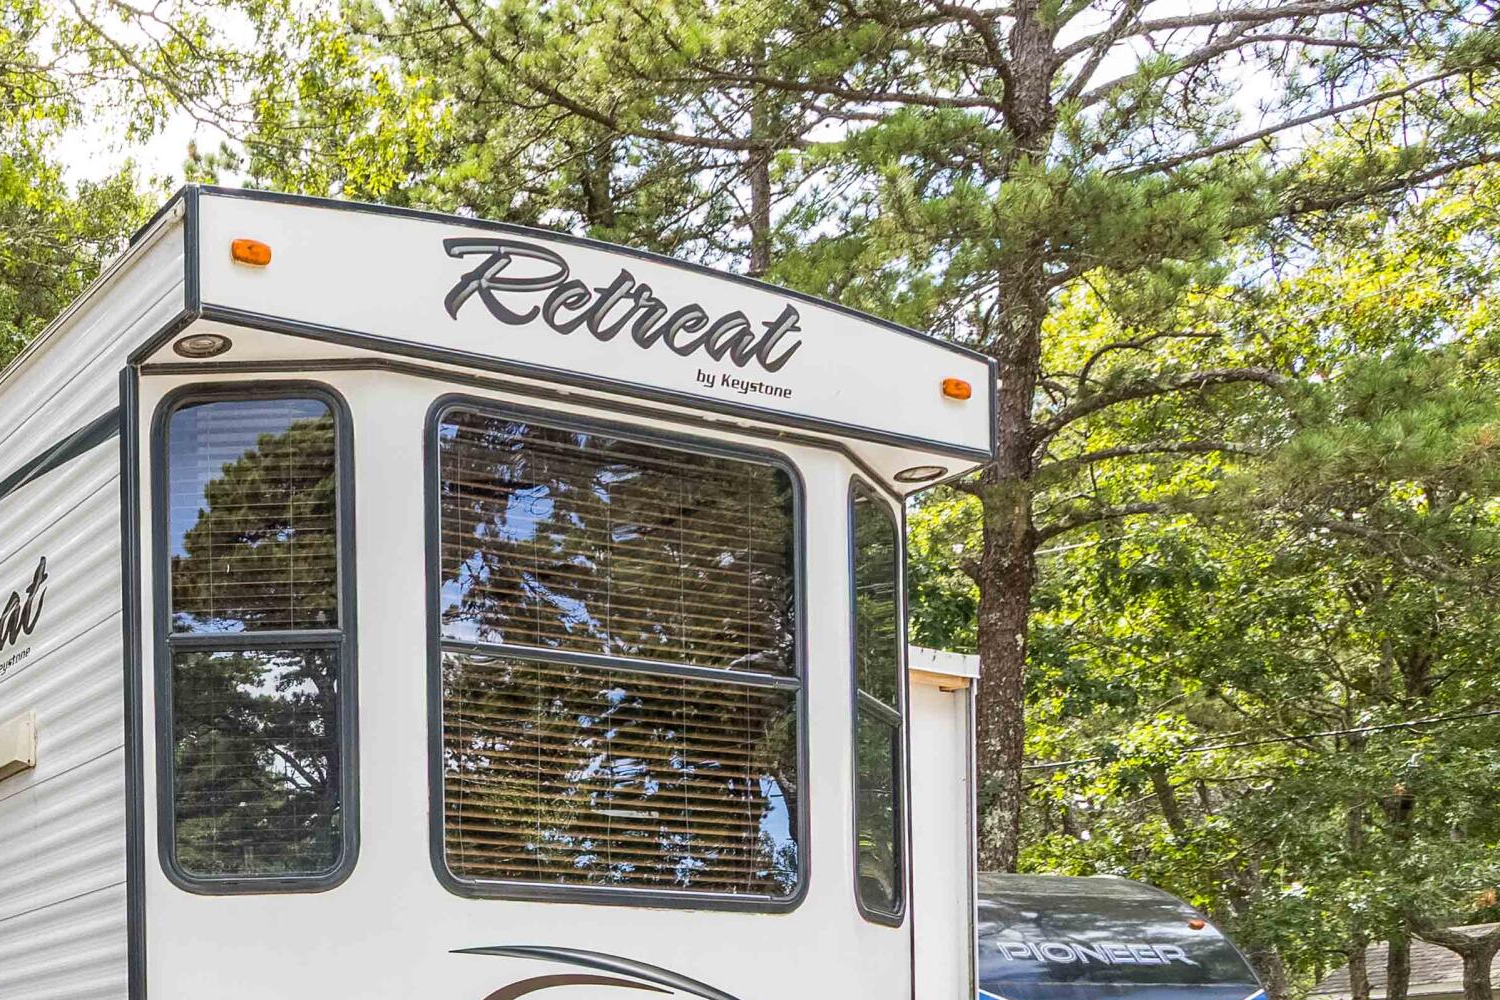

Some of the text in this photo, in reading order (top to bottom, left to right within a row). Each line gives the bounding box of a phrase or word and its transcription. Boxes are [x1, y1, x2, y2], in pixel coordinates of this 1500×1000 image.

[444, 238, 802, 373] Retreat
[696, 368, 793, 399] by Keystone
[997, 941, 1199, 965] PIONEER
